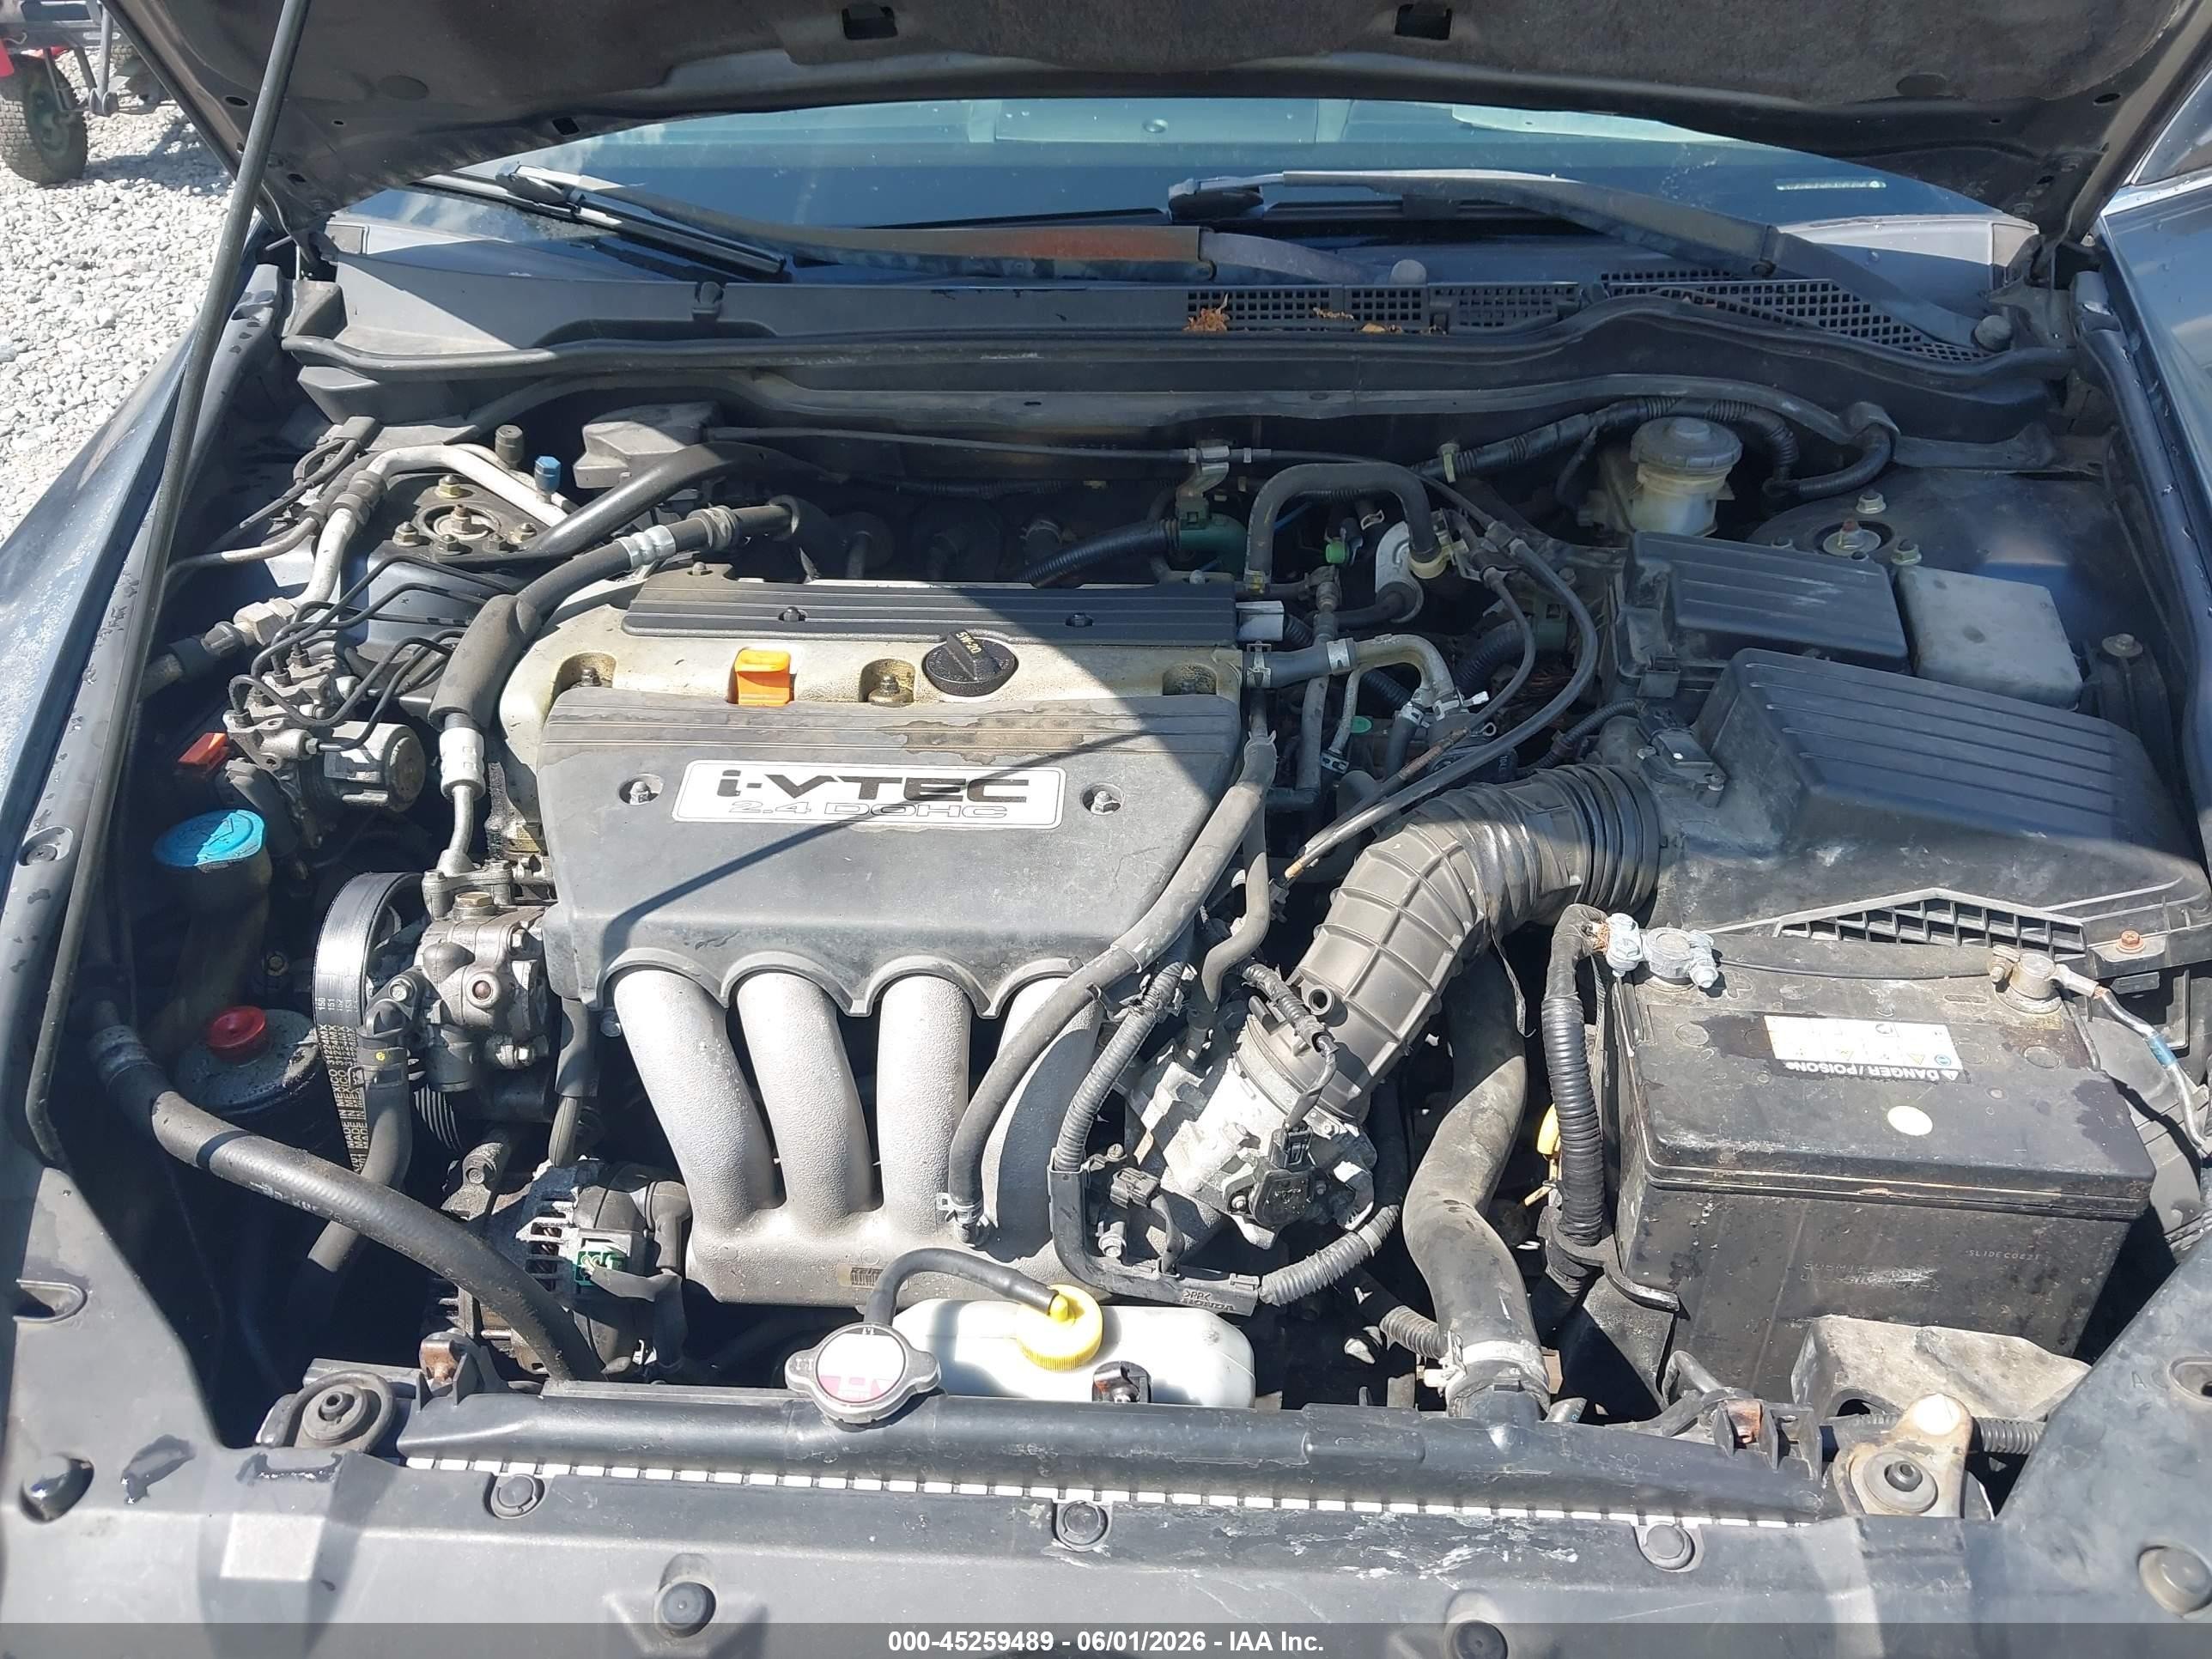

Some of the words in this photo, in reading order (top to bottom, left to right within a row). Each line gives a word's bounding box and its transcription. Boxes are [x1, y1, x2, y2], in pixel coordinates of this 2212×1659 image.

[956, 631, 982, 653] 5W-20
[716, 769, 1030, 803] i-VTEC
[728, 800, 811, 815] 2.4
[824, 801, 1007, 818] DOHC
[1867, 1065, 1940, 1081] DANGER
[328, 1068, 345, 1108] MEXICO
[349, 1121, 364, 1149] MADE
